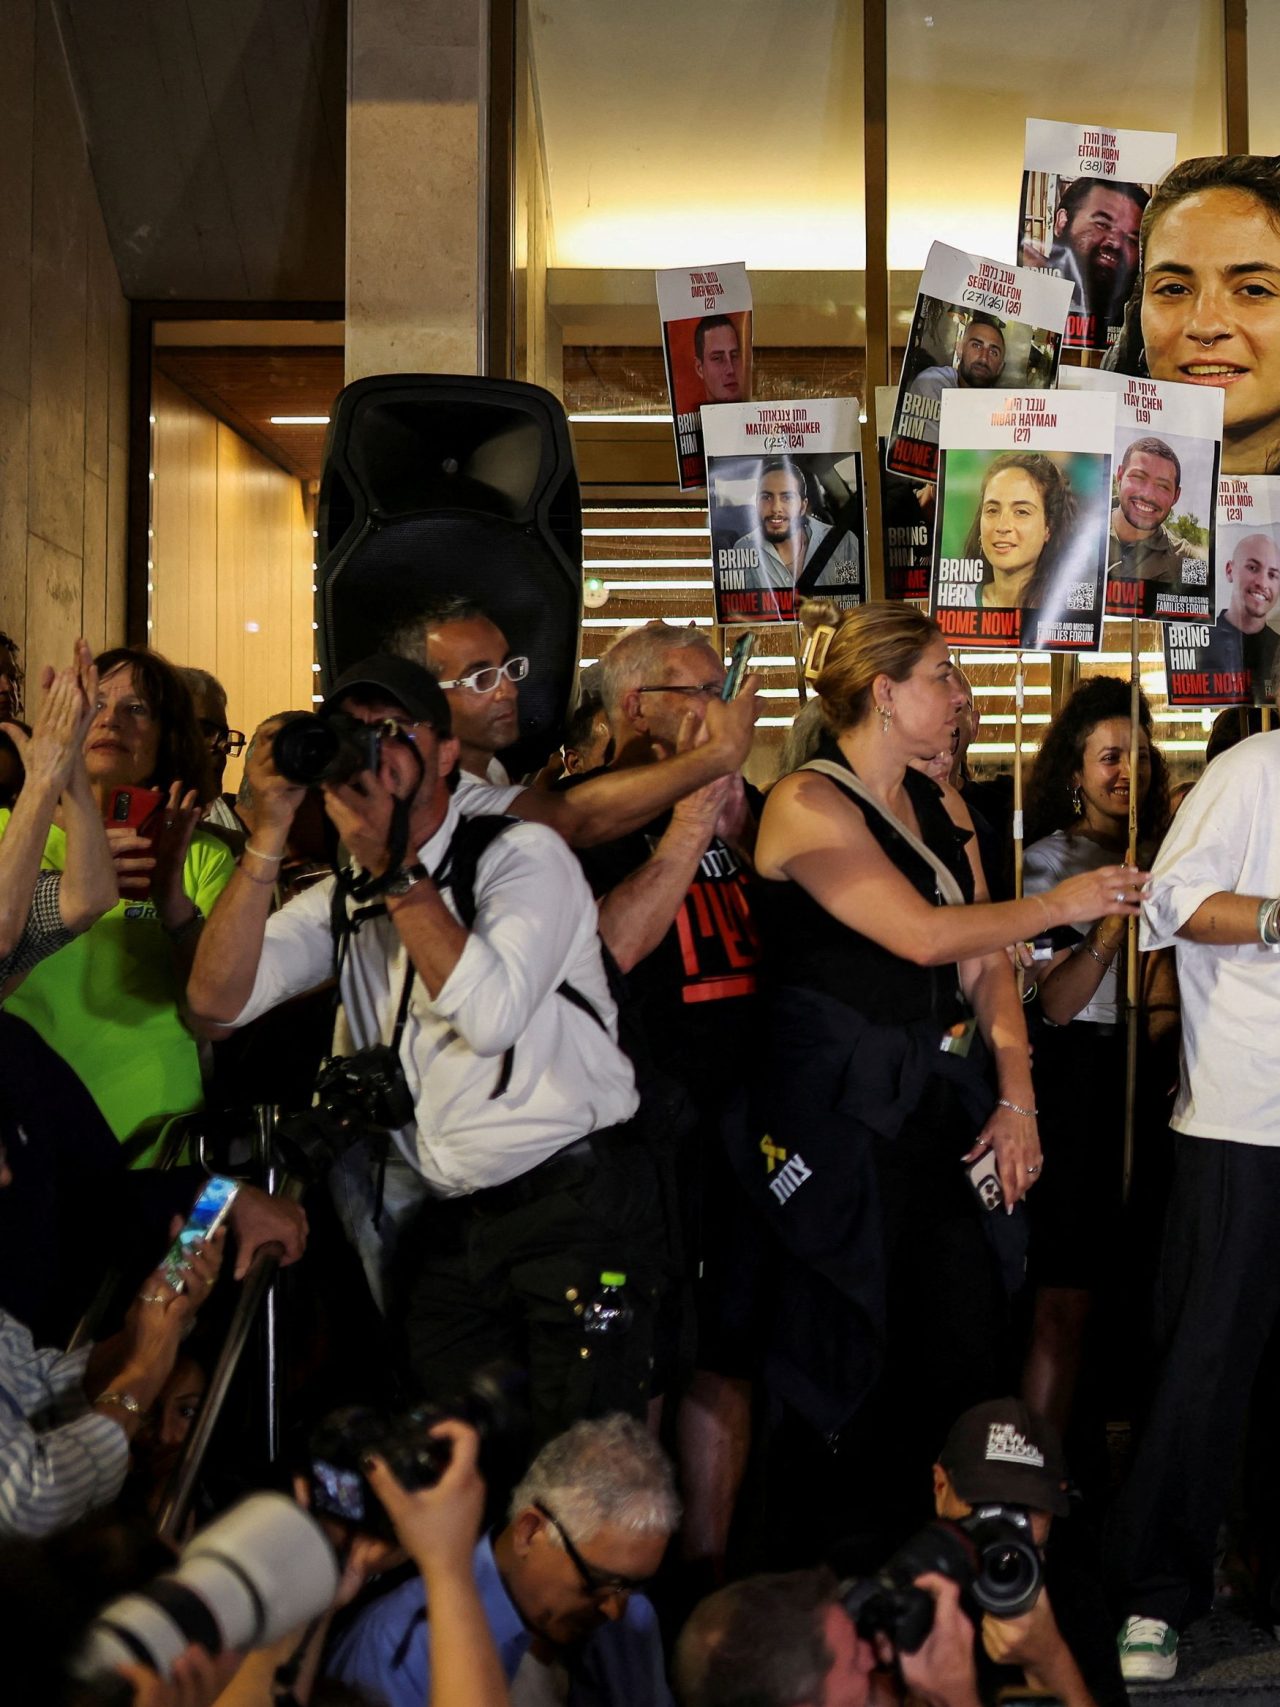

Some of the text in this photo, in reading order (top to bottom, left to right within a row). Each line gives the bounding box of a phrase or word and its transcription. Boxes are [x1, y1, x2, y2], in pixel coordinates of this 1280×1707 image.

[1083, 132, 1117, 148] איתן הורן
[1078, 145, 1120, 161] EITAN HORN
[1080, 160, 1103, 174] (38)
[978, 263, 998, 281] כלפון
[998, 270, 1016, 285] שגב
[967, 275, 1022, 301] SEGEV KALFON
[704, 297, 716, 311] (22)
[1128, 379, 1157, 397] איתי חן
[902, 391, 941, 422] BRING
[1024, 398, 1046, 412] ענבר
[1123, 392, 1163, 411] ITAY CHEN
[757, 409, 807, 423] מתן צנגאוקר
[1018, 414, 1058, 428] HAYMAN
[1135, 408, 1151, 425] (19)
[898, 414, 927, 441] HIM
[1013, 427, 1031, 443] (27)
[680, 433, 698, 456] HIM
[893, 438, 932, 468] HOME
[1236, 495, 1254, 508] MOR
[1227, 508, 1243, 521] (23)
[888, 526, 929, 547] BRING
[718, 548, 760, 570] BRING
[938, 558, 984, 583] BRING
[719, 569, 746, 591] HIM
[720, 589, 800, 614] HOME NOW!
[937, 583, 967, 607] HER
[1156, 600, 1209, 615] FAMILIES FORUM
[936, 608, 1022, 636] HOME NOW!
[1069, 631, 1094, 643] FORUM
[1168, 625, 1210, 648] BRING
[1170, 648, 1197, 671] HIM
[1172, 673, 1210, 695] HOME
[1213, 671, 1252, 695] NOW!
